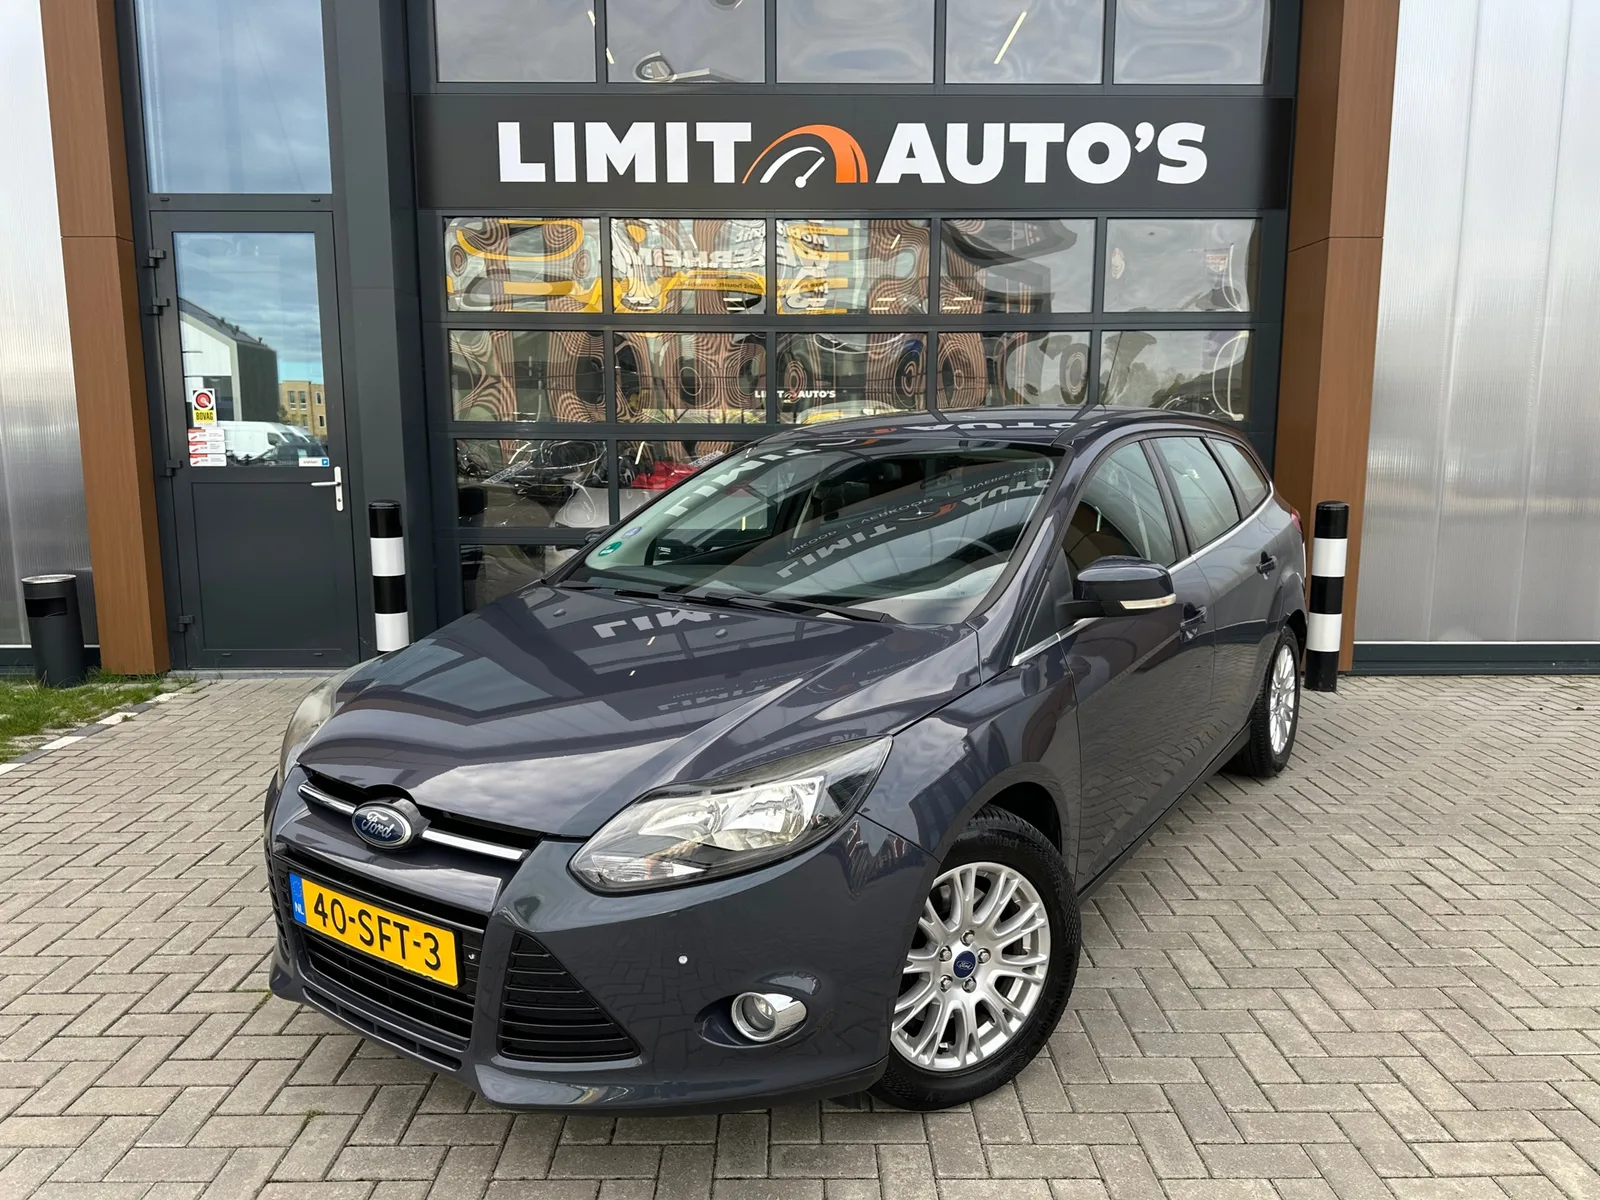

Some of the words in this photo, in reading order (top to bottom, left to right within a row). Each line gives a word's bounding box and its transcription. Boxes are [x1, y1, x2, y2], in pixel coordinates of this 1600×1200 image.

[498, 121, 752, 183] LIMIT
[875, 122, 1208, 184] AUTO'S
[798, 390, 836, 398] AUTO'S
[195, 412, 214, 421] BOVAG
[360, 811, 395, 839] Ford
[294, 903, 305, 916] NL
[313, 892, 441, 971] 40-SFT-3
